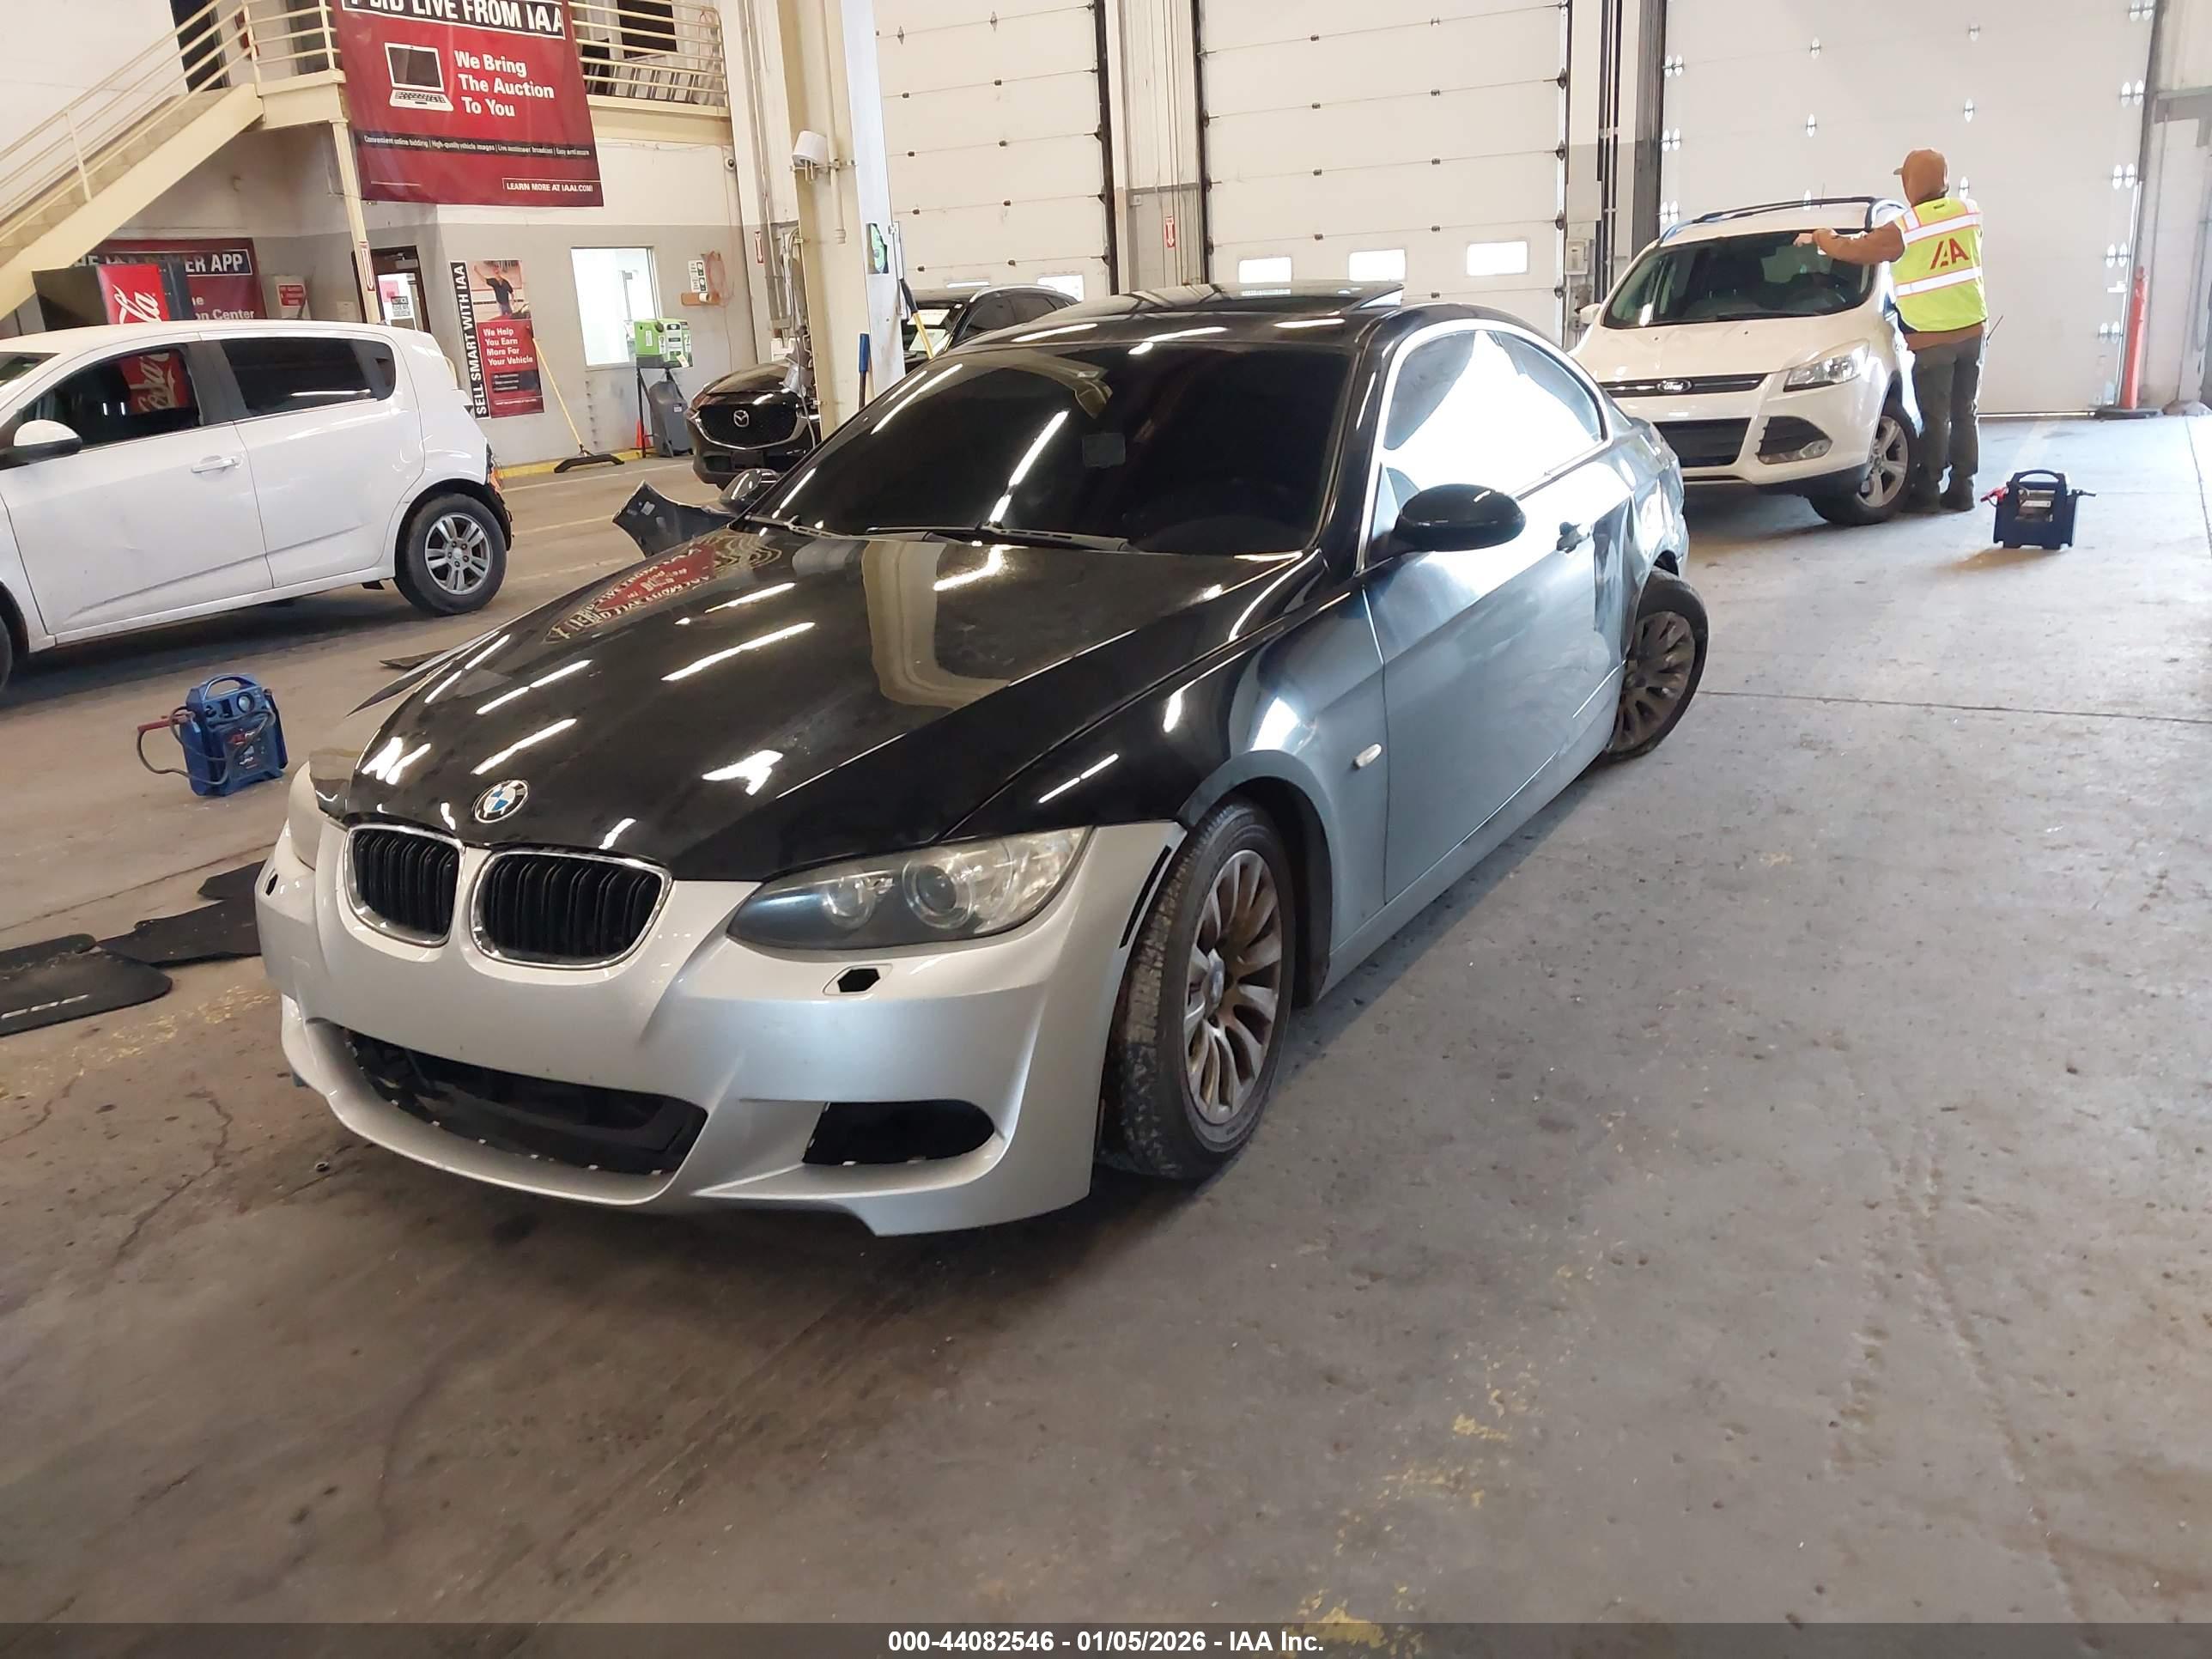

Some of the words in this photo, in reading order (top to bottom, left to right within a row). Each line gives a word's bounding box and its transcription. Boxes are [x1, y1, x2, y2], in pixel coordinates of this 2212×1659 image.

[412, 0, 459, 19] LIVE
[463, 0, 523, 28] FROM
[526, 4, 563, 33] IAA
[454, 50, 481, 69] We
[483, 53, 527, 78] Bring
[458, 73, 489, 93] The
[493, 77, 555, 99] Auction
[461, 96, 482, 114] To
[485, 98, 515, 117] You
[532, 183, 550, 191] MORE
[185, 256, 206, 272] ER
[210, 253, 243, 272] APP
[453, 265, 469, 290] IAA
[212, 308, 255, 320] Center
[458, 294, 474, 331] WITH
[483, 328, 495, 337] We
[496, 327, 514, 337] Help
[501, 337, 518, 345] Earn
[465, 334, 482, 381] SMART
[486, 348, 506, 356] More
[488, 358, 505, 367] Your
[506, 355, 533, 365] Vehicle
[473, 386, 487, 415] SELL
